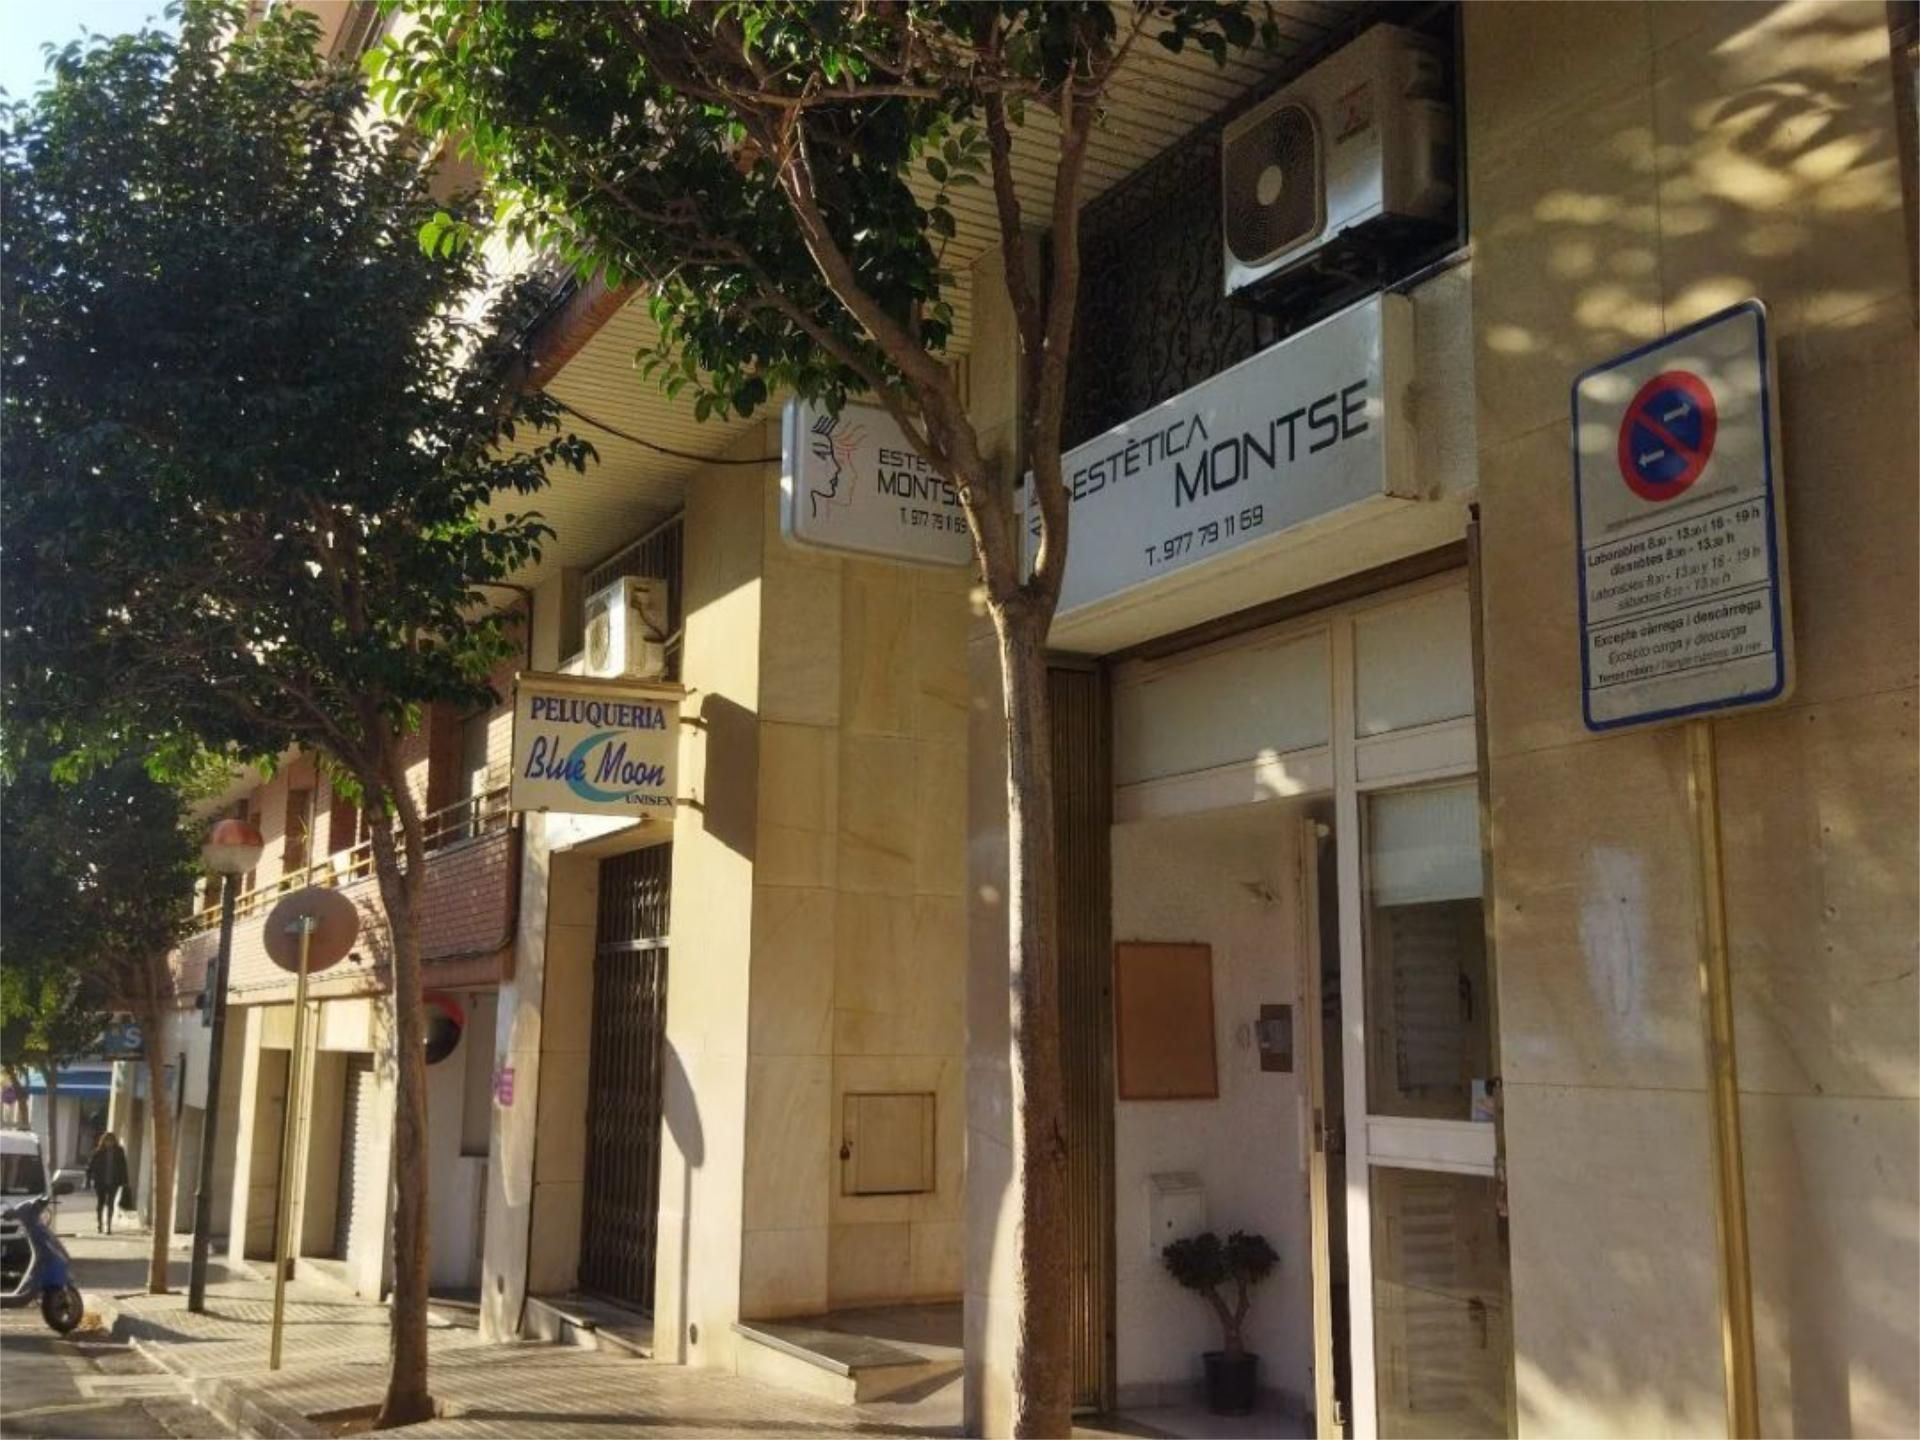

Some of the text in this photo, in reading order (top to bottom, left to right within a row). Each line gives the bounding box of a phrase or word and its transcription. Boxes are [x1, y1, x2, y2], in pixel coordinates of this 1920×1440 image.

[1072, 414, 1208, 502] ESTÈTICA
[1175, 379, 1368, 507] MONTSE
[1198, 521, 1218, 545] 79
[1225, 516, 1235, 537] 11
[1240, 504, 1264, 531] 69
[530, 696, 666, 729] PELUQUERIA
[524, 735, 665, 787] Blue Moon
[625, 794, 674, 807] UNISEX
